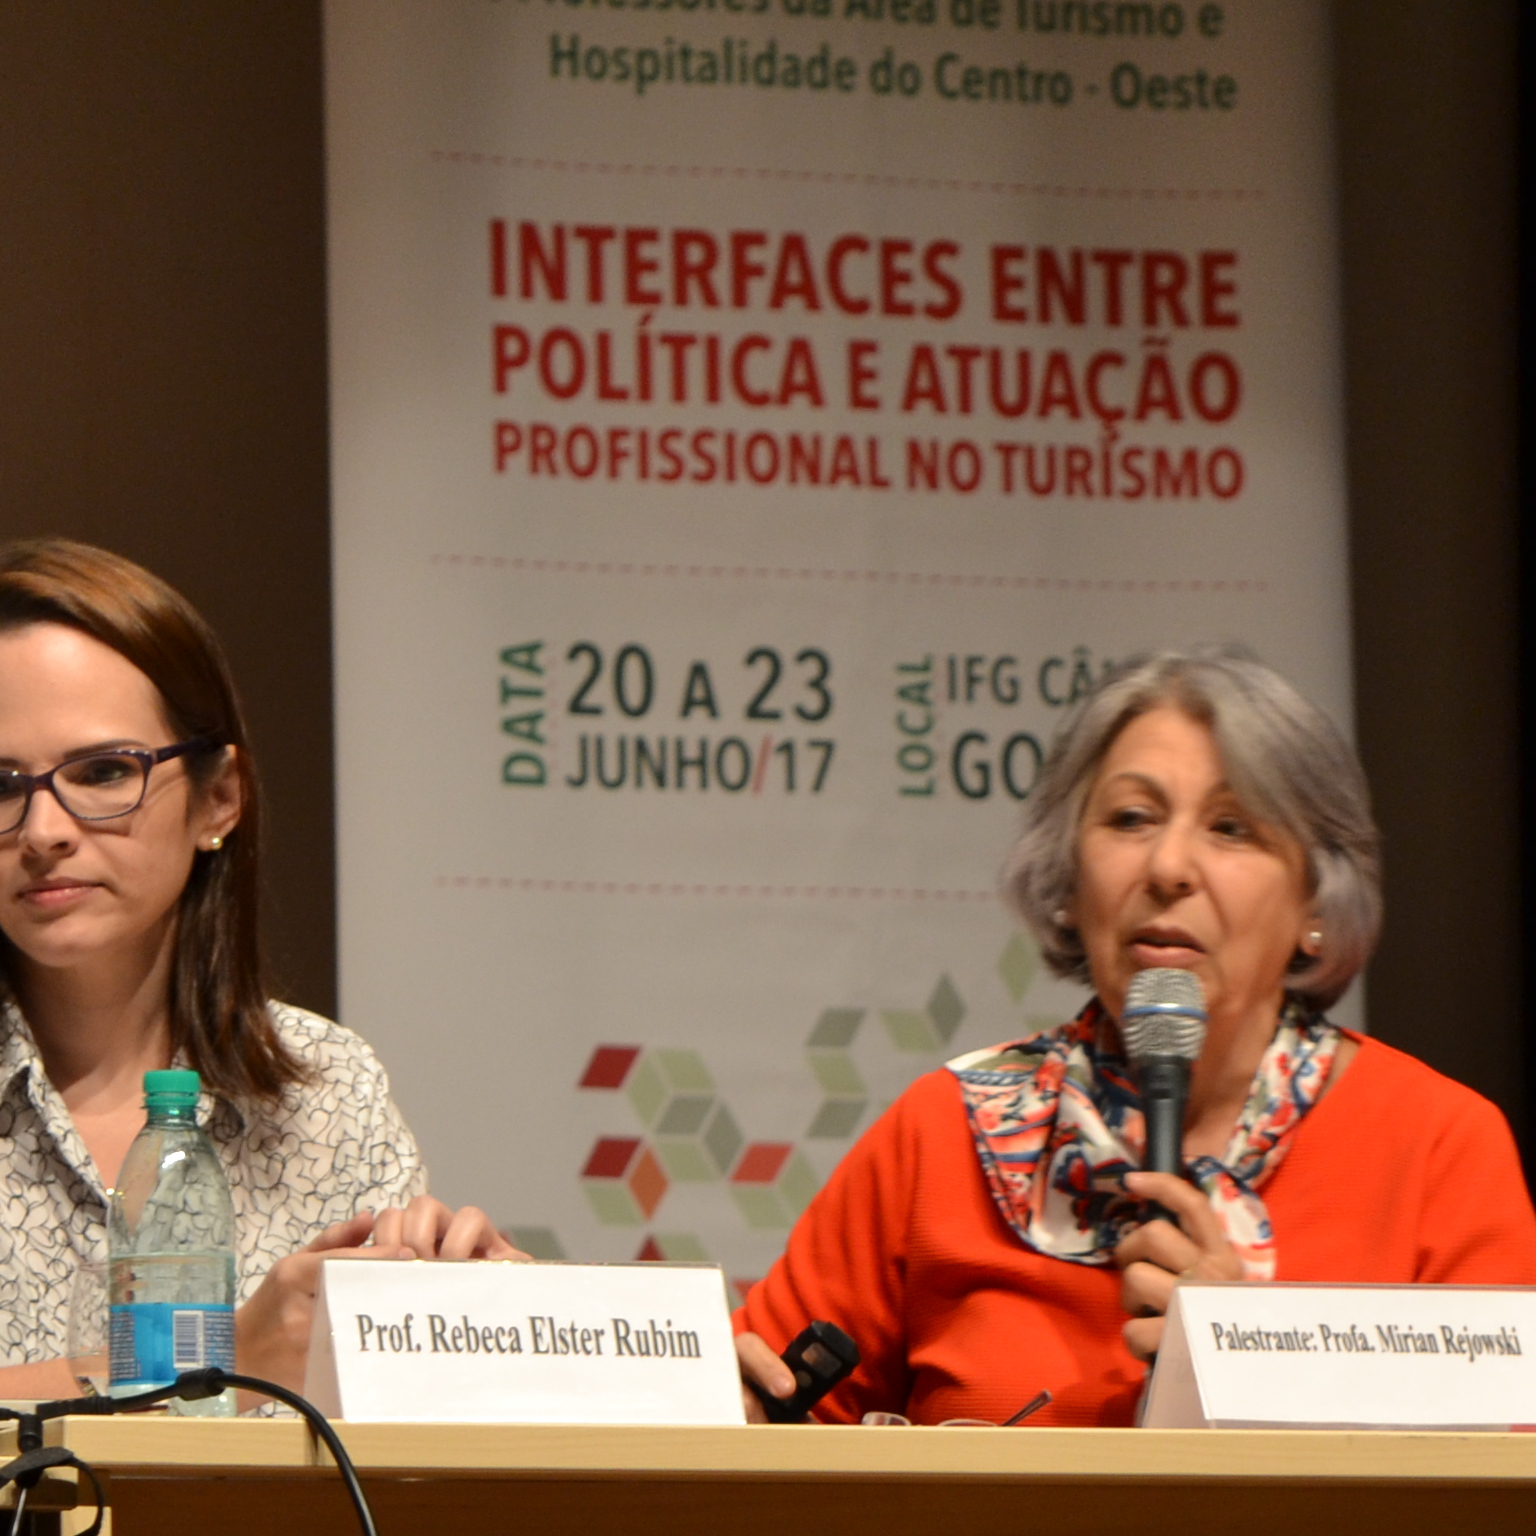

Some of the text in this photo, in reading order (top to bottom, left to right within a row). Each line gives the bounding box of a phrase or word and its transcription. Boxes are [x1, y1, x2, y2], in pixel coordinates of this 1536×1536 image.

[1198, 2, 1225, 37] e
[548, 33, 857, 95] Hospitalidade
[869, 46, 922, 97] do
[934, 51, 1072, 105] Centro
[1109, 60, 1237, 110] Oeste
[490, 219, 1241, 329] INTERFACES ENTRE
[493, 310, 1241, 443] POLÍTICA E ATUAÇÃO
[495, 421, 1244, 500] PROFISSIONAL NO TURISMO
[500, 638, 547, 789] DATA
[567, 641, 832, 722] 20 A 23
[946, 654, 1019, 706] IFG
[565, 733, 835, 793] JUNHO/17
[895, 653, 935, 798] LOCAL
[355, 1313, 702, 1358] Prof. Rebeca Elster Rubim
[1211, 1322, 1522, 1362] Palestrante: Profa. Mirian Rejowski
